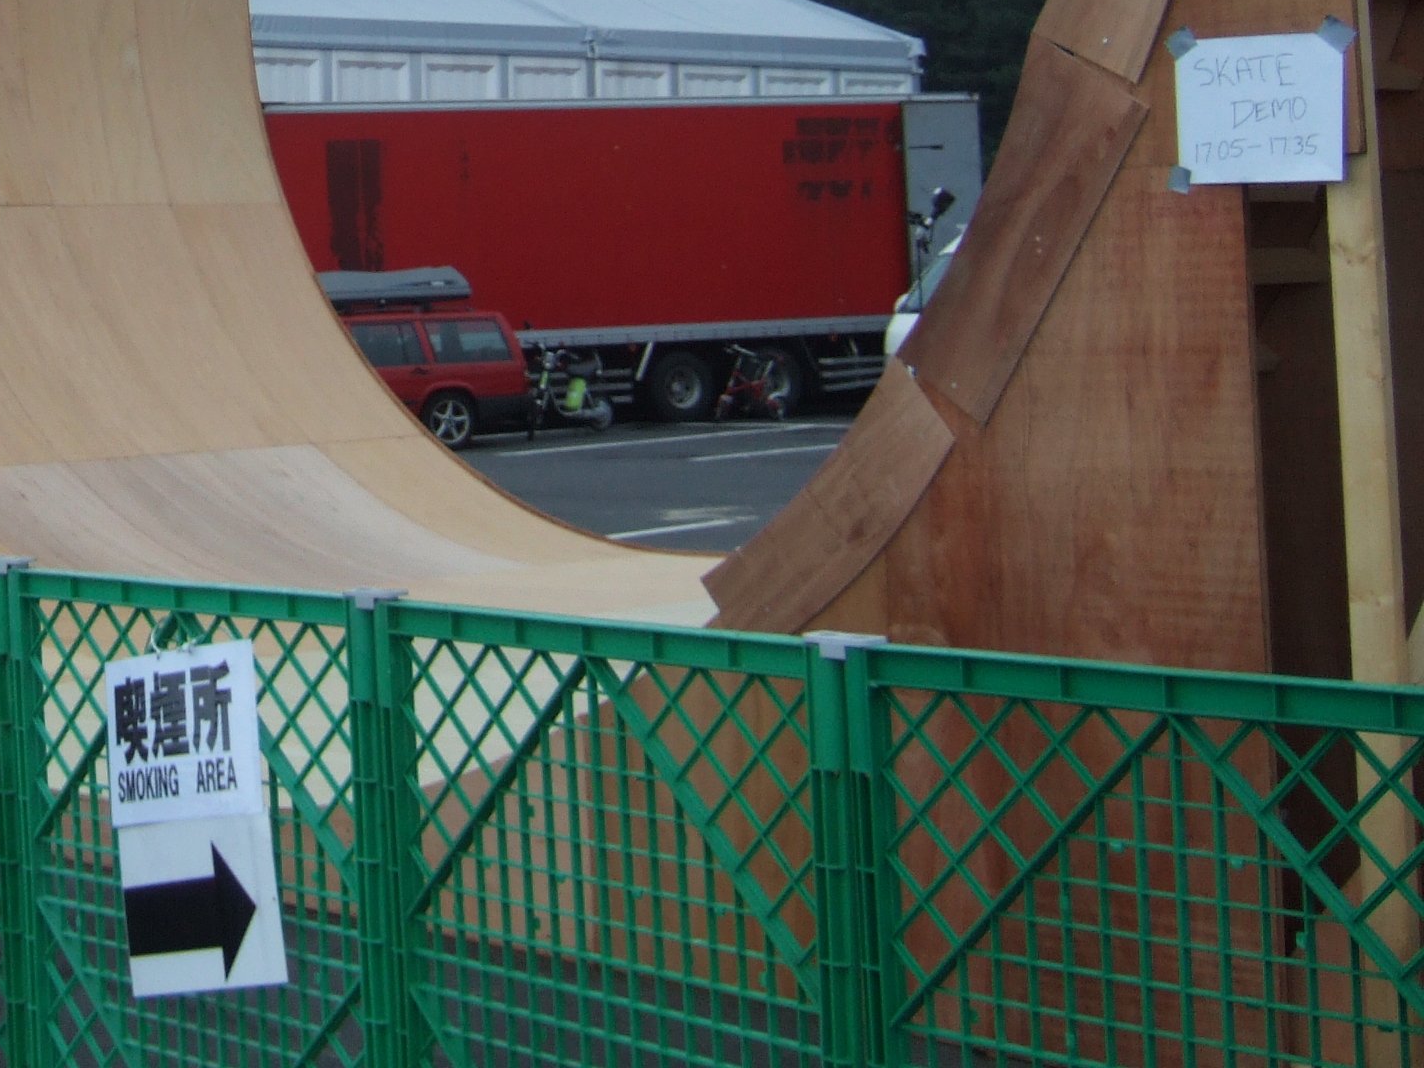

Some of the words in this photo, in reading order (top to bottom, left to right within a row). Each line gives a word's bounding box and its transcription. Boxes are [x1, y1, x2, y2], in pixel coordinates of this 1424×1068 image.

[1193, 53, 1295, 87] SKATE
[1232, 96, 1307, 129] DEMO
[113, 660, 232, 765] 喫煙所
[117, 768, 180, 804] SMOKING
[196, 756, 238, 794] AREA
